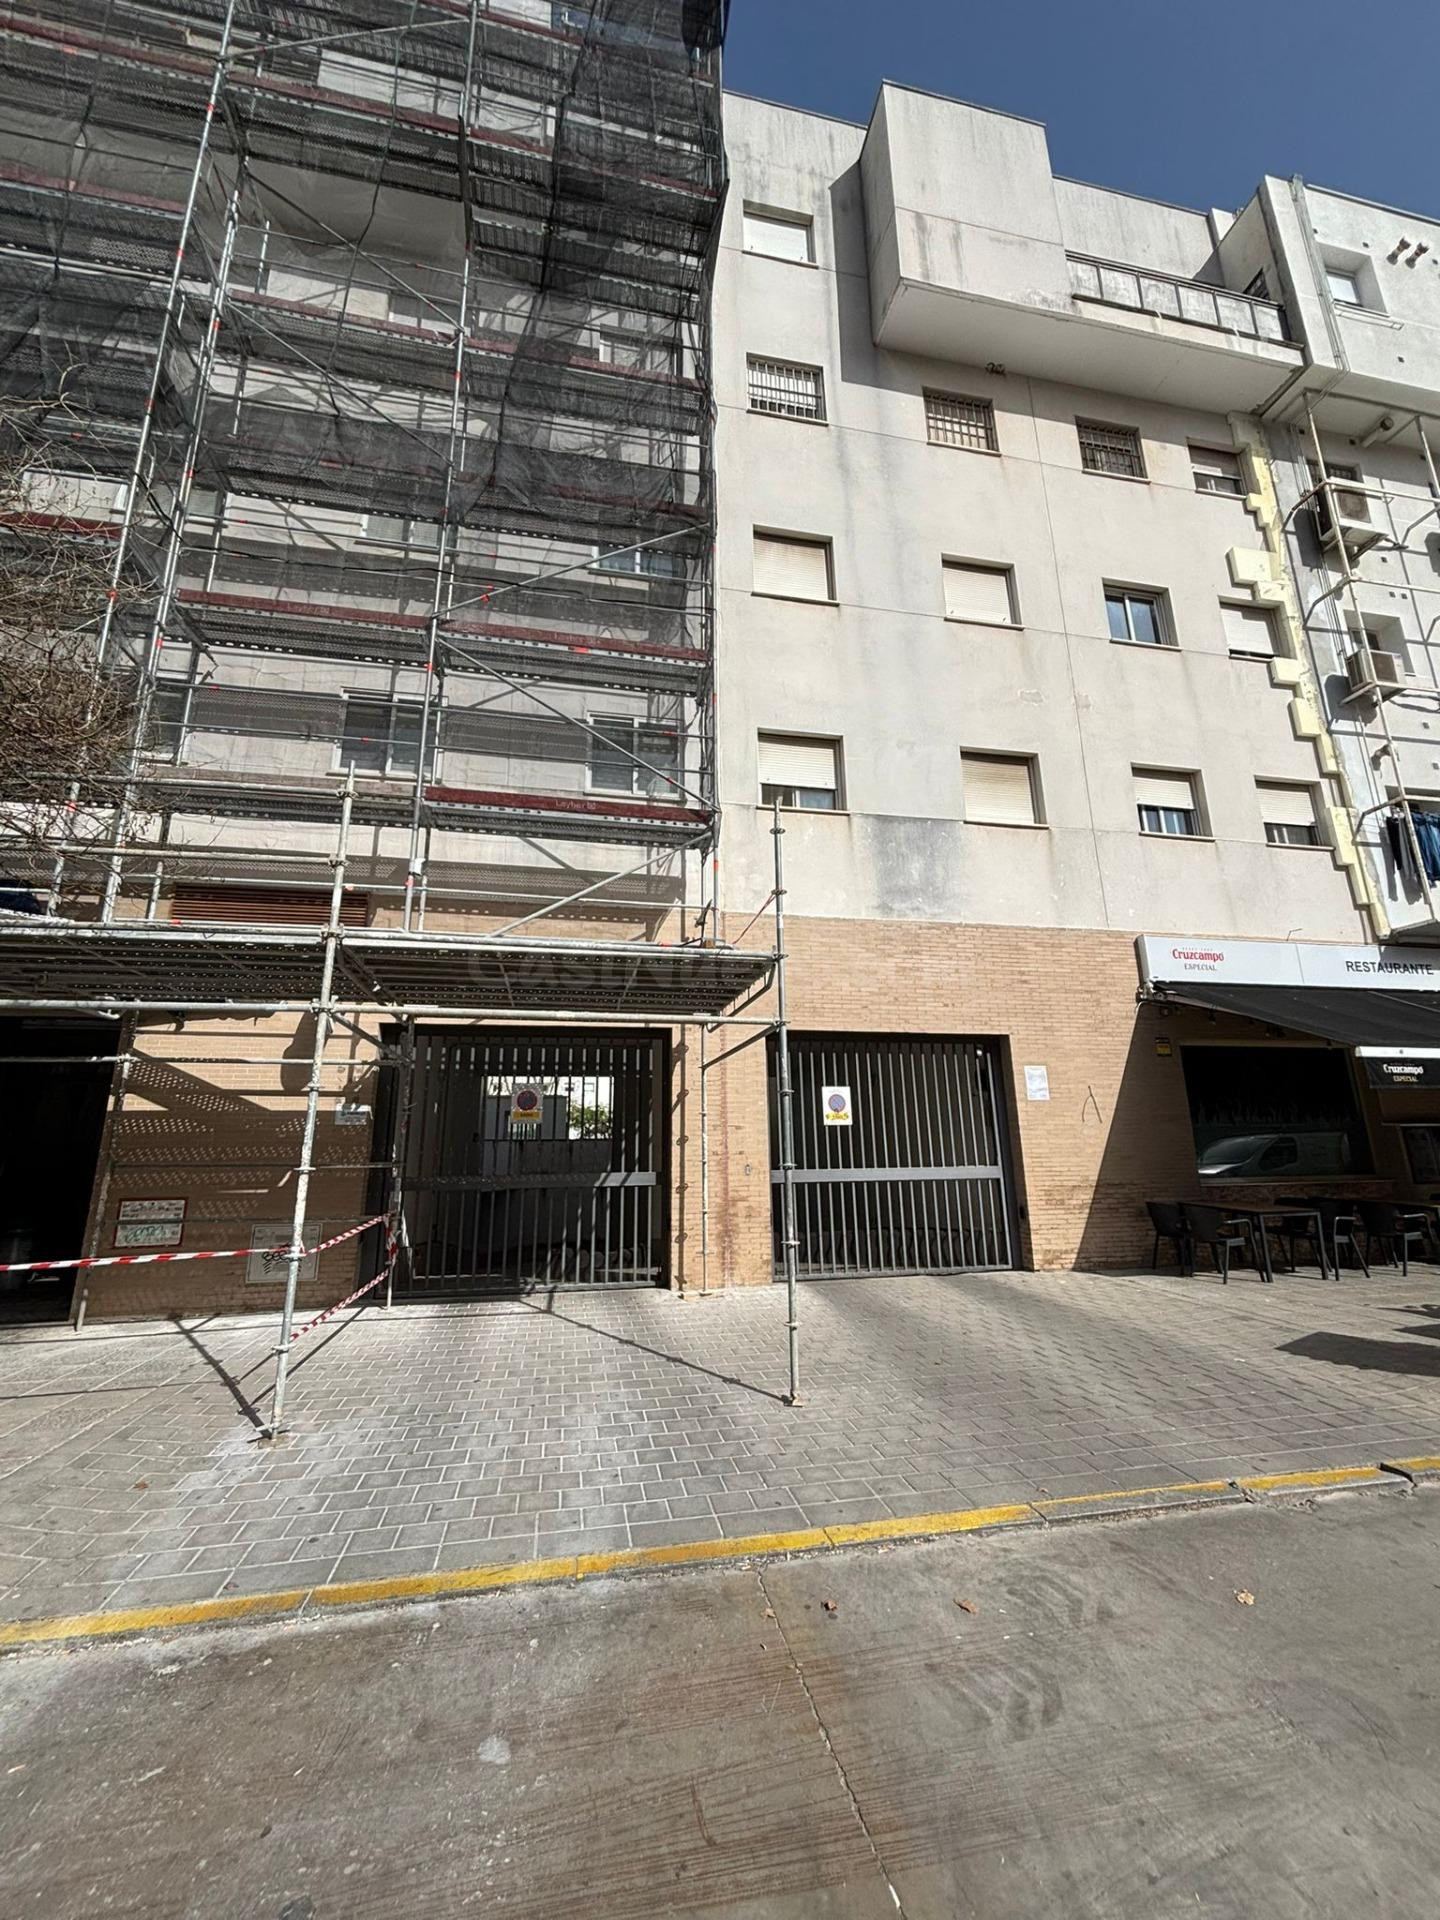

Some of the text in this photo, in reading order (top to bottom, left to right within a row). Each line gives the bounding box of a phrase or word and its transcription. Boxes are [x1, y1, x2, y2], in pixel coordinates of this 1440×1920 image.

[1172, 949, 1225, 963] Cruzcampo
[1184, 963, 1218, 972] ESPECIAL
[1345, 961, 1435, 976] RESTAURANTE
